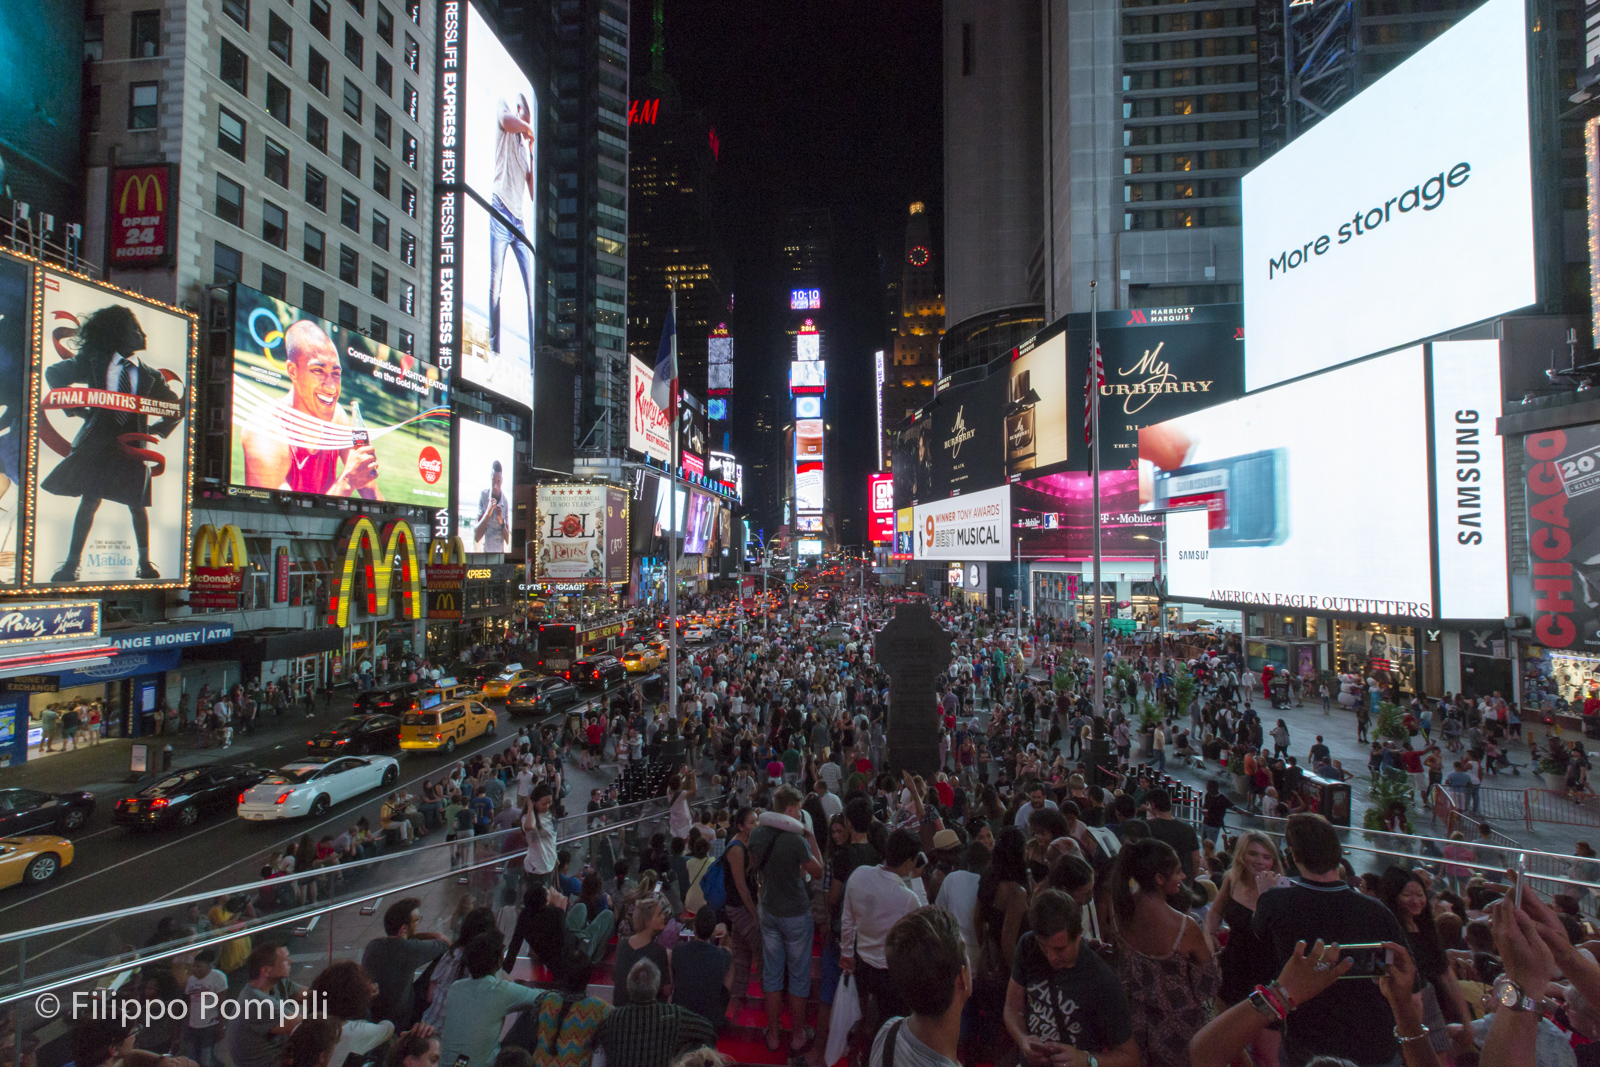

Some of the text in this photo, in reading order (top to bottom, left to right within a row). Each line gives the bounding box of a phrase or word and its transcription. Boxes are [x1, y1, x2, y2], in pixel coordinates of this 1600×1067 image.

[442, 72, 457, 148] EXPRESS
[122, 216, 160, 227] OPEN
[1269, 161, 1471, 280] More storage
[125, 228, 155, 245] 24
[116, 246, 164, 257] HOURS
[793, 290, 819, 300] 10:10
[439, 268, 454, 344] EXPRESS
[1151, 307, 1195, 316] MARRIOTT
[1151, 315, 1190, 323] MARQUIS
[1019, 336, 1037, 350] MARRIOTT
[1019, 343, 1035, 356] MARQUIS
[347, 346, 448, 392] Congratulations ASHTON EATON
[373, 370, 429, 396] on the Gold Medal
[1084, 380, 1214, 397] URBERRY
[50, 391, 136, 410] FINAL MONTHS
[140, 397, 153, 405] SEE
[159, 400, 181, 410] BEFORE
[139, 405, 175, 416] JANUARY
[646, 432, 656, 443] BEST
[655, 438, 670, 451] MUSICAL
[944, 428, 976, 450] BURBERRY
[419, 457, 441, 472] Coca-Cola
[1561, 456, 1595, 479] 20
[1455, 409, 1483, 546] SAMSUNG
[546, 512, 596, 538] LOL
[926, 504, 1000, 547] 9 WINNER TONY AWARDS
[935, 525, 1000, 547] BEST MUSICAL
[1525, 429, 1577, 648] CHICAGO
[610, 537, 623, 555] CATS
[86, 552, 133, 568] Matilda
[191, 574, 240, 583] McDonald's
[1210, 589, 1431, 618] AMERICAN EAGLE OUTFITTERS
[0, 612, 47, 636] Paris
[53, 614, 62, 624] A
[155, 631, 200, 646] MONEY
[207, 628, 231, 639] ATM
[7, 684, 57, 692] EXCHANGE
